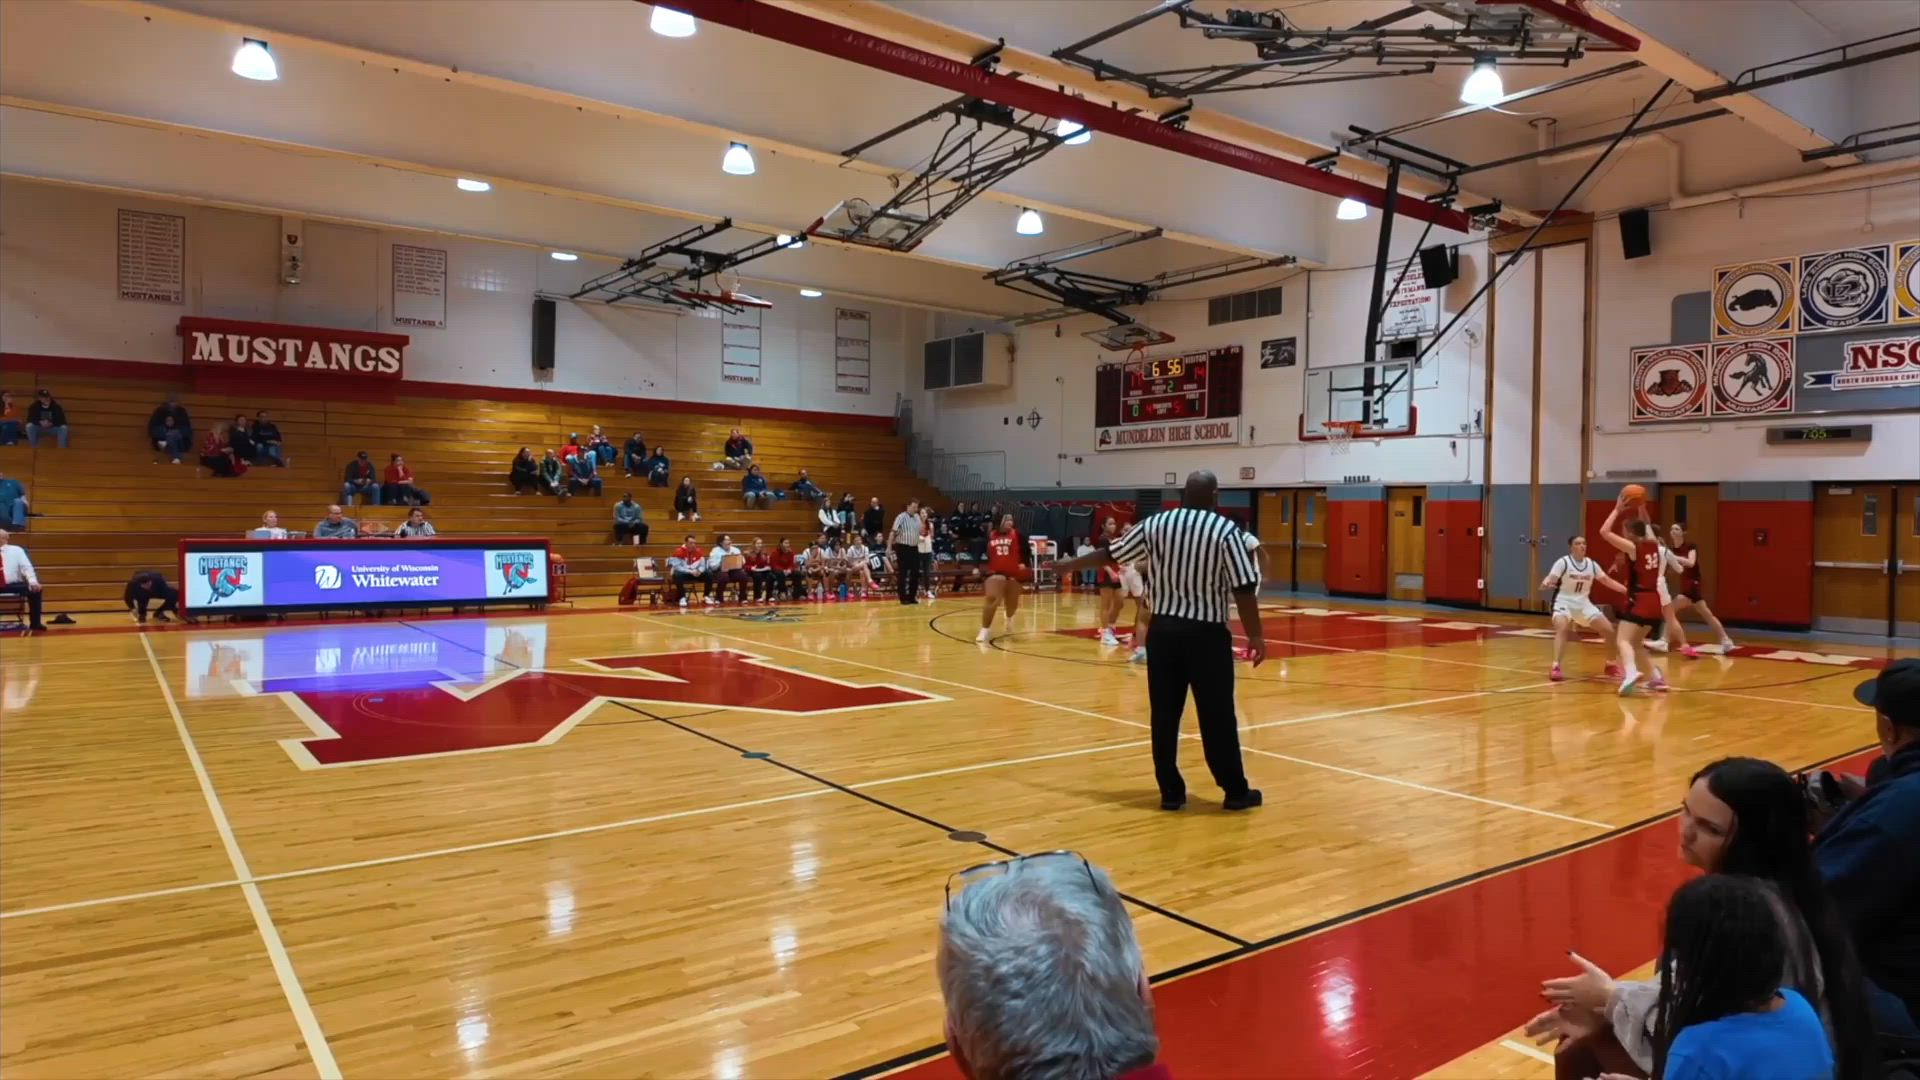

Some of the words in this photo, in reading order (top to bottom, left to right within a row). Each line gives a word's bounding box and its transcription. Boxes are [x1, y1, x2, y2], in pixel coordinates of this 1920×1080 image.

[1810, 253, 1842, 274] ZURICH
[1844, 251, 1867, 261] HIGH
[1866, 257, 1888, 289] SCHOOL
[1825, 317, 1862, 328] BEARS
[191, 331, 401, 374] MUSTANGS
[1669, 349, 1691, 359] HIGH
[1712, 343, 1747, 387] MUNDELEIN
[1748, 342, 1773, 351] HIGH
[1771, 347, 1793, 381] SCHOOL
[1837, 376, 1859, 385] NORTH
[1861, 374, 1899, 384] SUBURBAN
[1725, 398, 1778, 413] MUSTANGS
[1115, 427, 1166, 445] MUNDELEIN
[1168, 425, 1192, 441] HIGH
[1194, 422, 1233, 440] SCHOOL
[199, 555, 248, 576] MUSTANGS
[351, 565, 390, 574] University
[391, 564, 401, 573] of
[401, 564, 439, 573] Wisconsin
[494, 552, 535, 571] MUSTANGS
[351, 573, 440, 589] Whitewater
